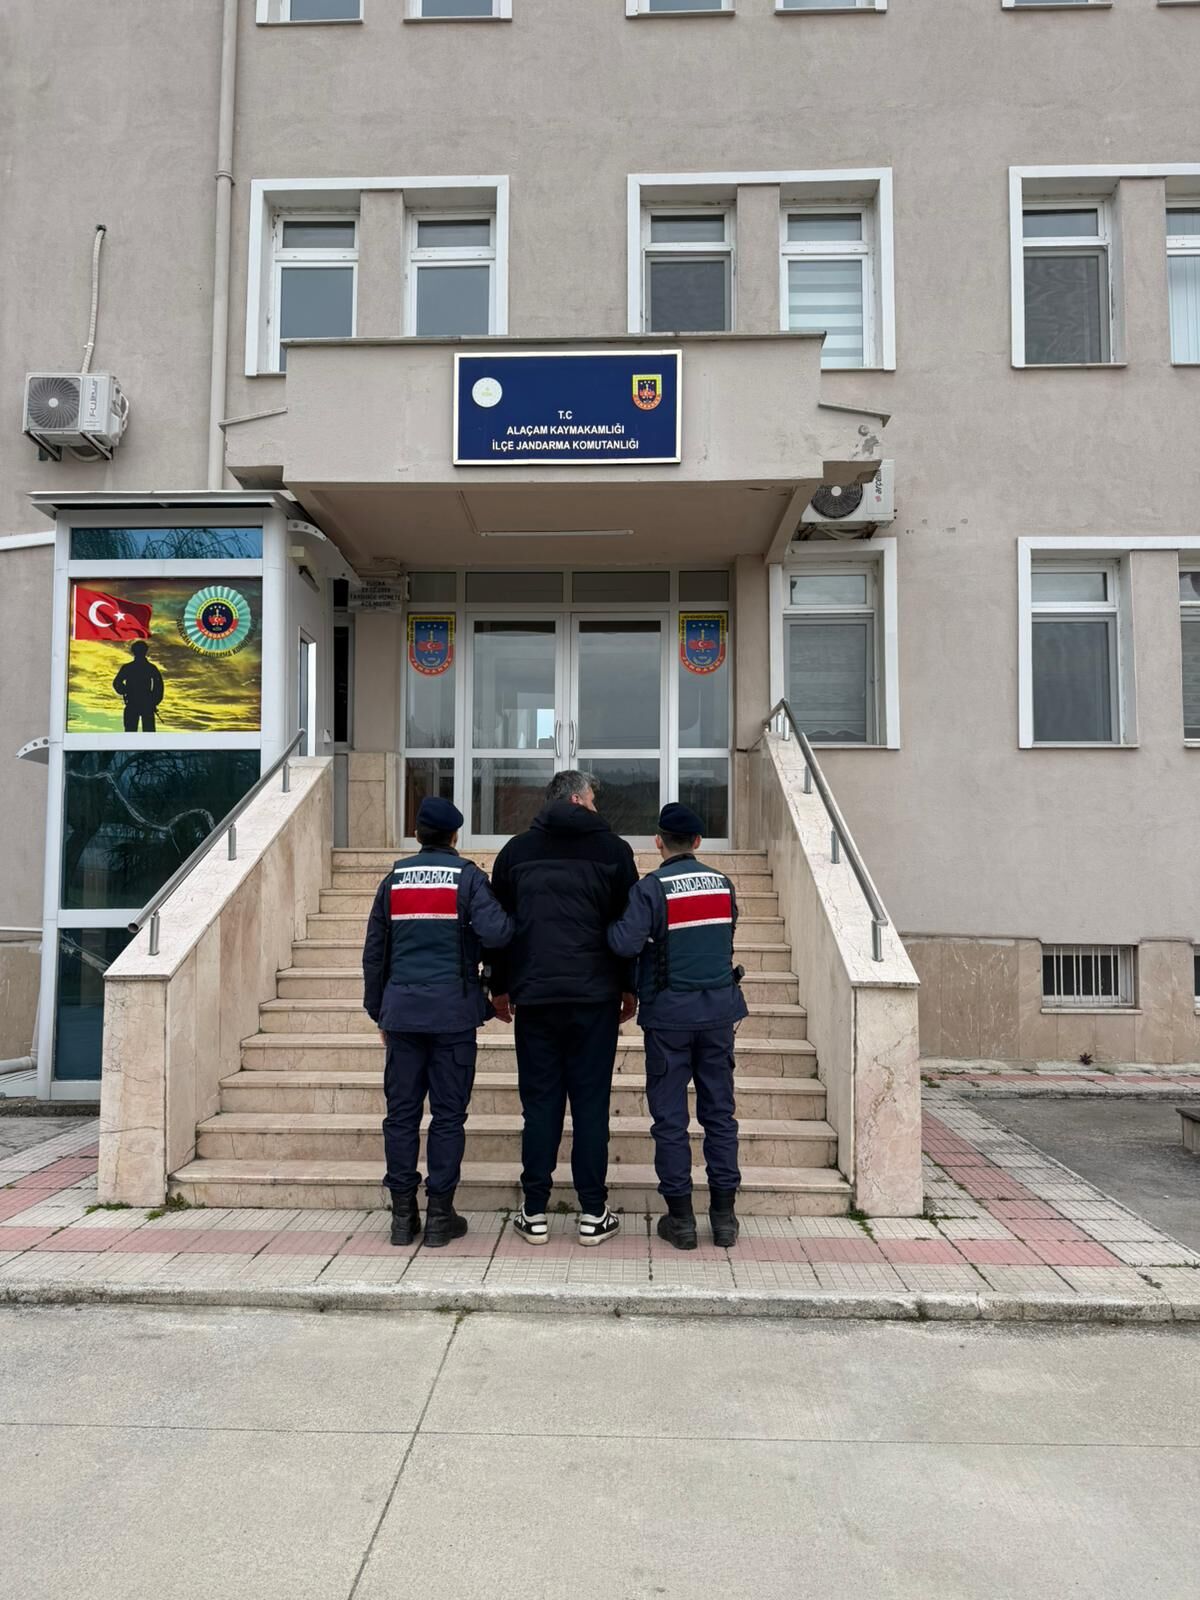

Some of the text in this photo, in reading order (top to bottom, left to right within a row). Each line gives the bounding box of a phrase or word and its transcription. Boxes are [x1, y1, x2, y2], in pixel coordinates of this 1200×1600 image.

[557, 410, 573, 420] T.C
[506, 423, 625, 436] ALAÇAM KAYMAKAMLIĞI
[492, 437, 639, 451] İLÇE JANDARMA KOMUTANLIĞI
[399, 870, 454, 884] JANDARMA
[670, 876, 724, 893] JANDARMA
